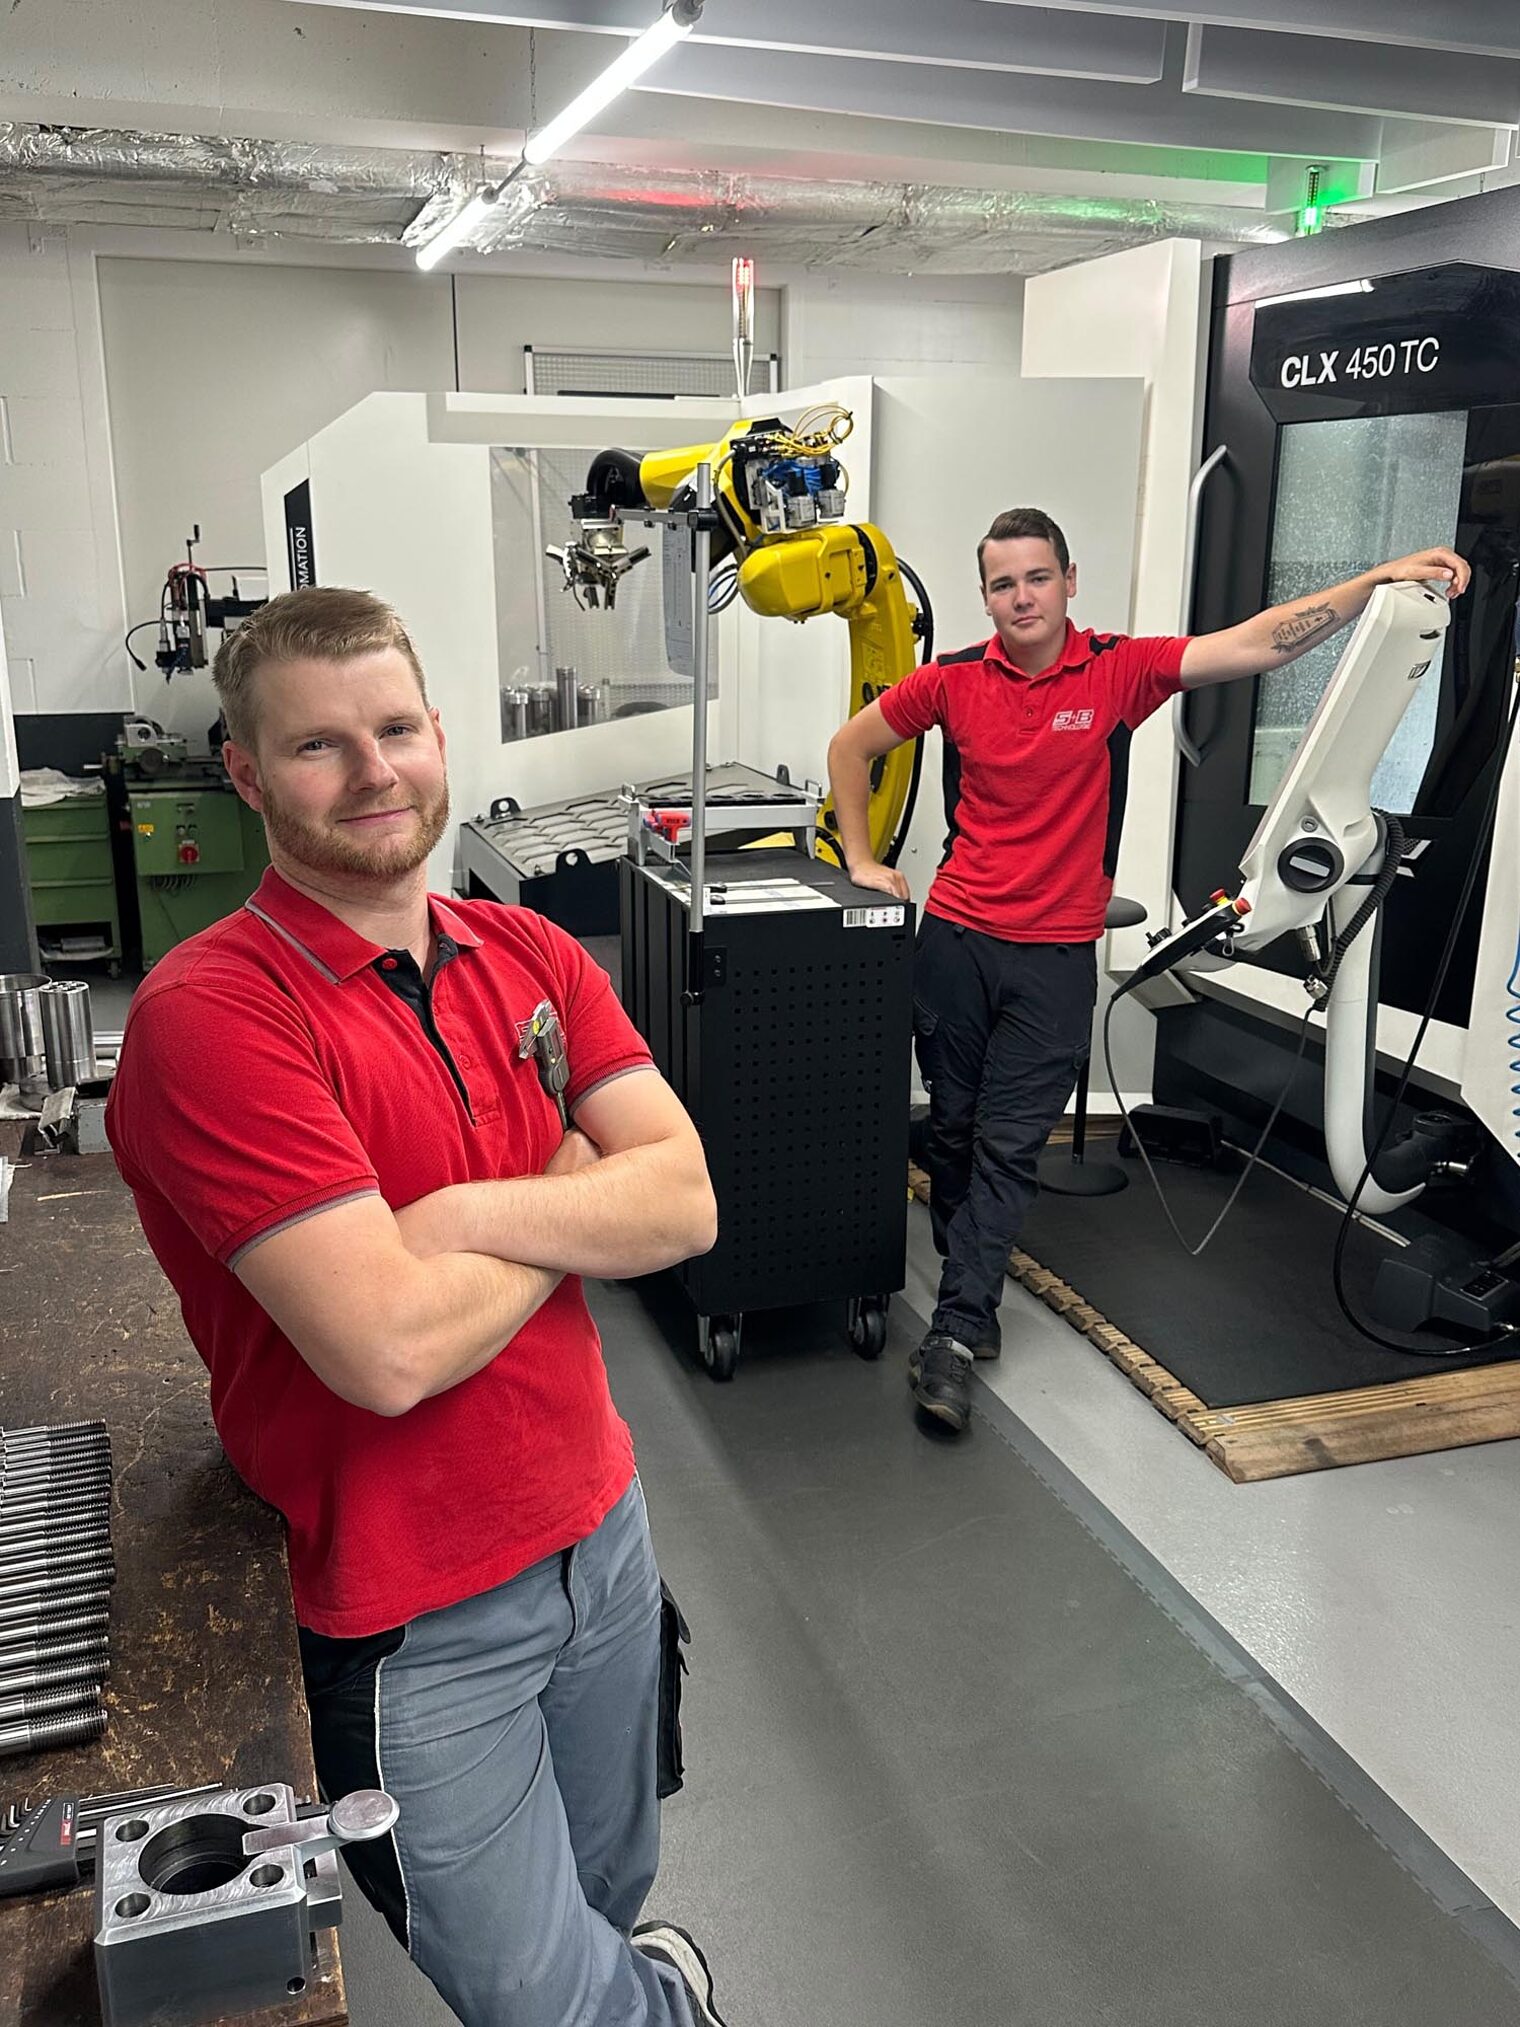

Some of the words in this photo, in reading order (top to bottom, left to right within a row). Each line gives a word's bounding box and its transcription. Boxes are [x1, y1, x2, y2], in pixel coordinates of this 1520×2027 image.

[1281, 350, 1339, 388] CLX
[1345, 343, 1396, 380] 450
[1400, 337, 1440, 374] TC
